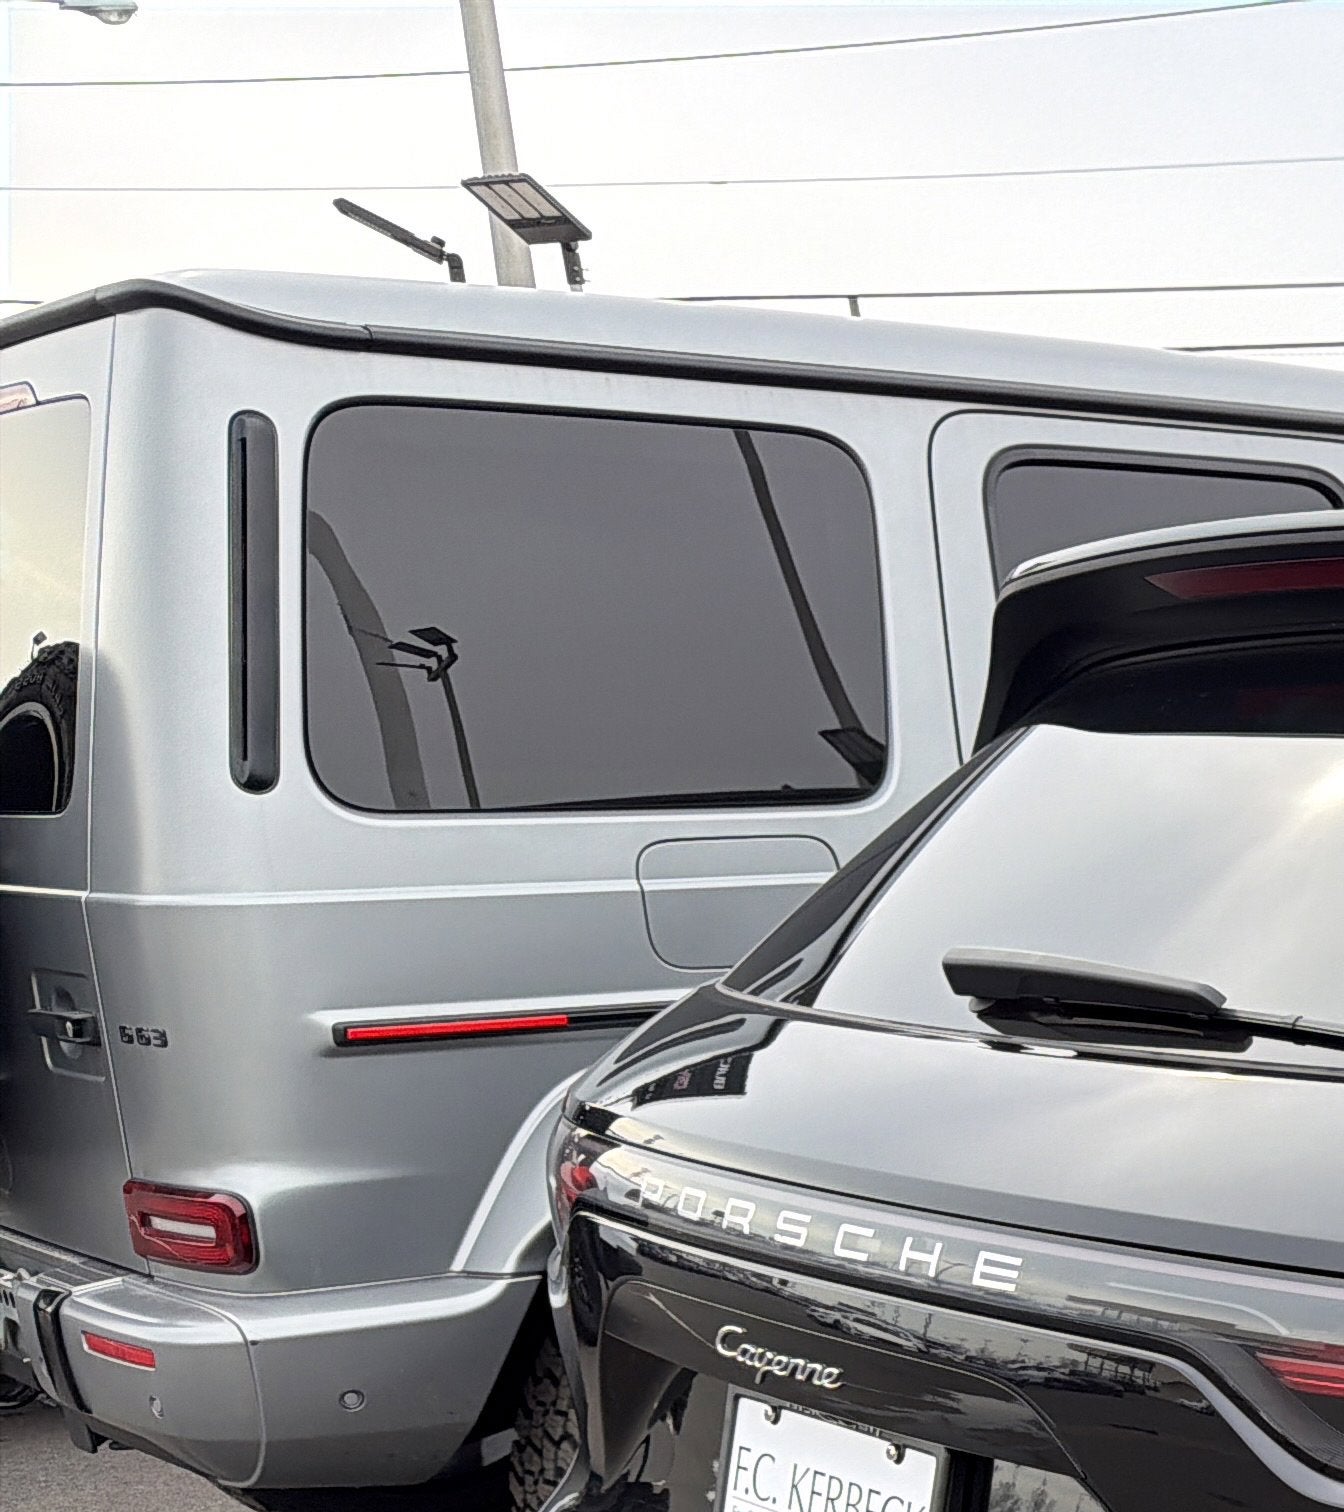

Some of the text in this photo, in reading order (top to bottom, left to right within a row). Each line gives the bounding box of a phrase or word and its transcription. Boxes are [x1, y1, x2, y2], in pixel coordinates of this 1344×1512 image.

[639, 1177, 1023, 1292] PORSCHE
[715, 1325, 844, 1389] Cayenne
[733, 1446, 777, 1505] F.C.
